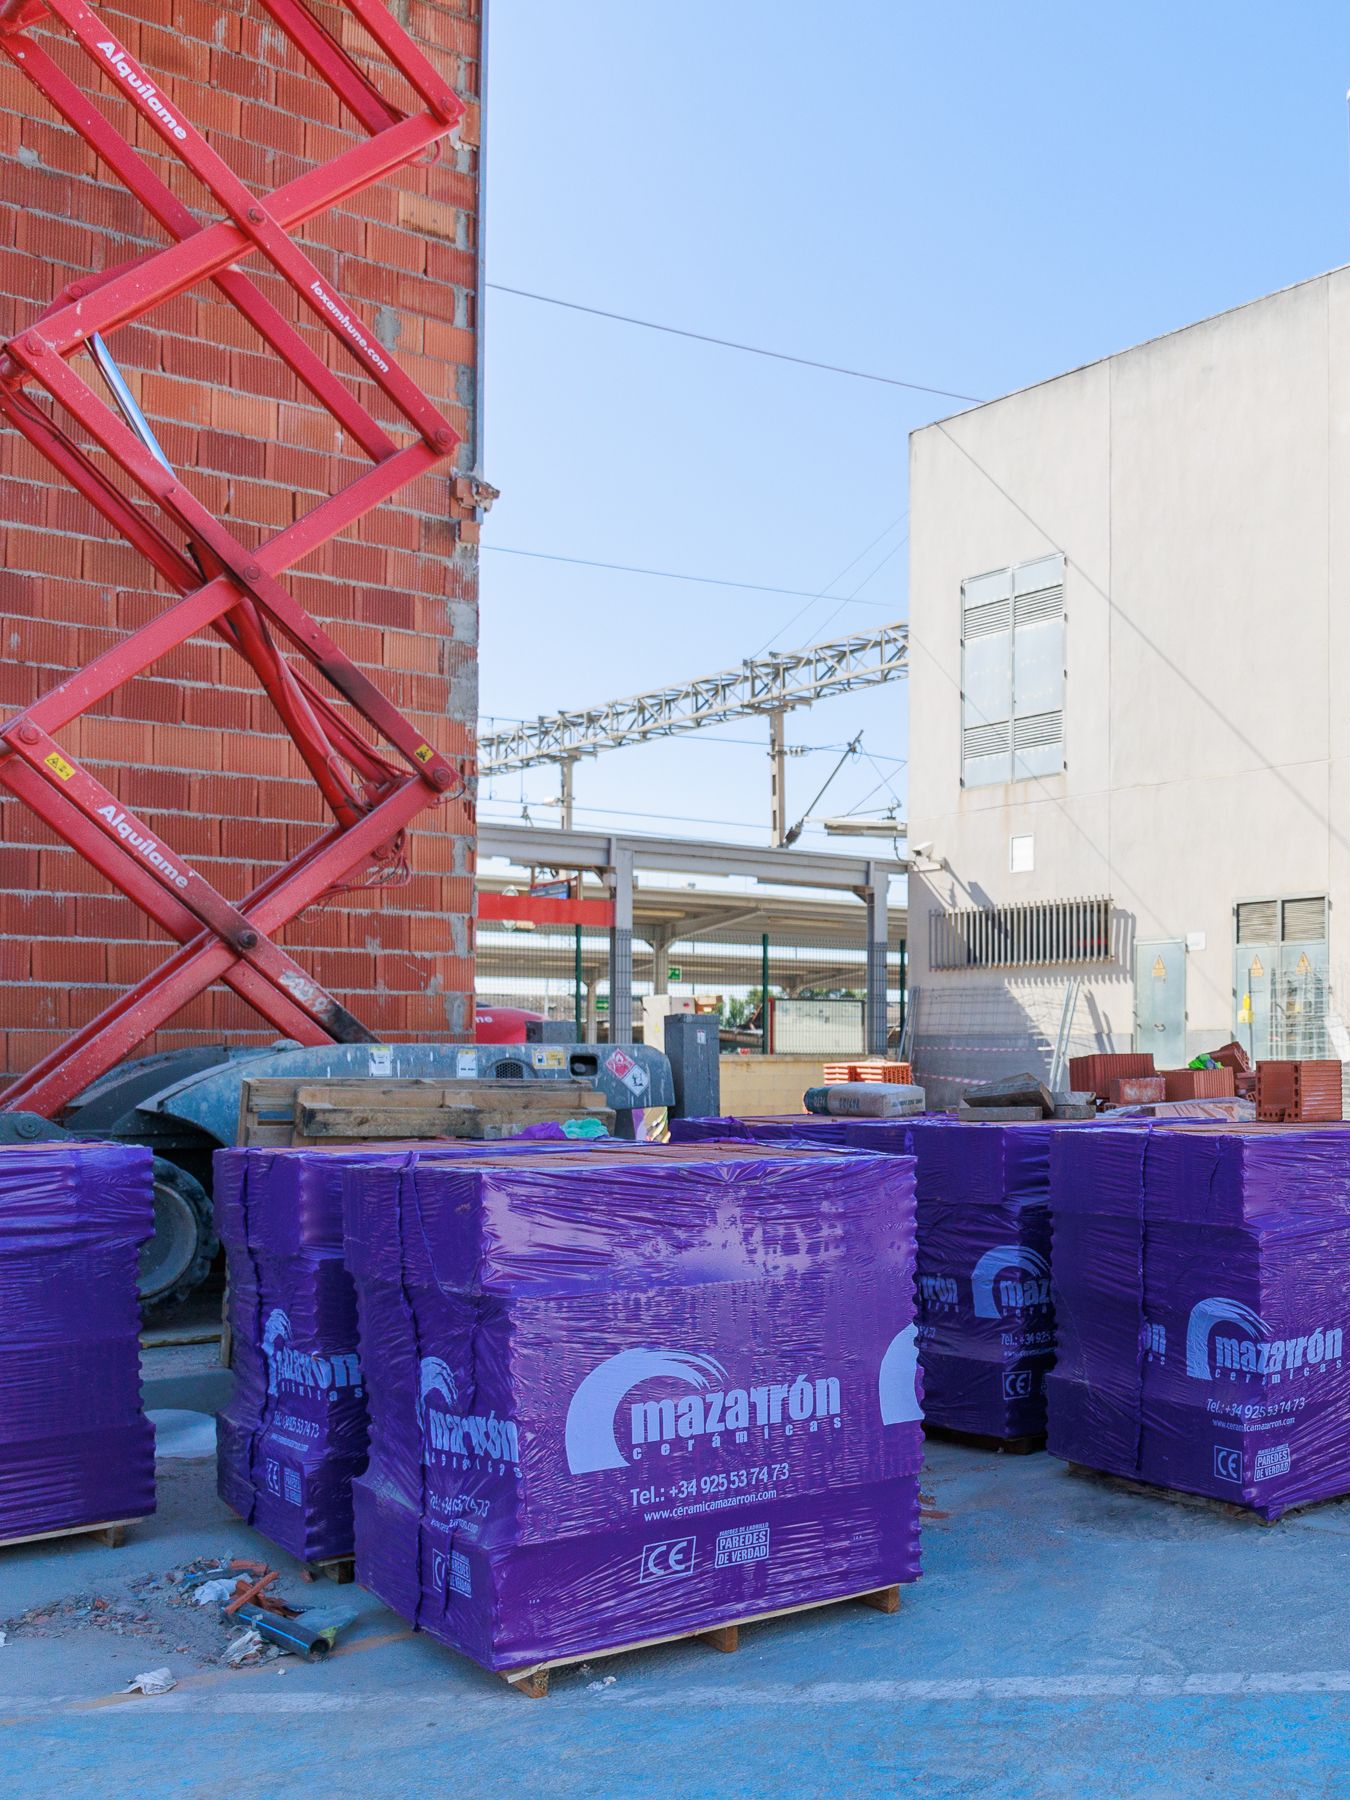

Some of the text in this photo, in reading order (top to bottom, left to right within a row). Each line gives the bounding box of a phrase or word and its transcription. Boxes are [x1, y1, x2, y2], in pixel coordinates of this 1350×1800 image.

[310, 280, 389, 373] loxamhune.com
[1215, 1326, 1343, 1375] mazarrón
[631, 1374, 841, 1445] mazarrón
[1225, 1403, 1243, 1417] +34
[1244, 1404, 1266, 1419] 925
[1267, 1404, 1279, 1417] 53
[1280, 1400, 1291, 1414] 74
[1293, 1397, 1306, 1411] 73
[633, 1416, 841, 1460] cerámicas
[1256, 1467, 1264, 1479] DE
[1257, 1450, 1288, 1467] PAREDES
[630, 1462, 789, 1506] Tel.: +34 925 53 74 73
[644, 1490, 777, 1522] www.ceramicamazarron.com
[718, 1545, 766, 1565] DE VERDAD
[719, 1531, 766, 1551] PAREDES
[648, 1541, 688, 1575] CE
